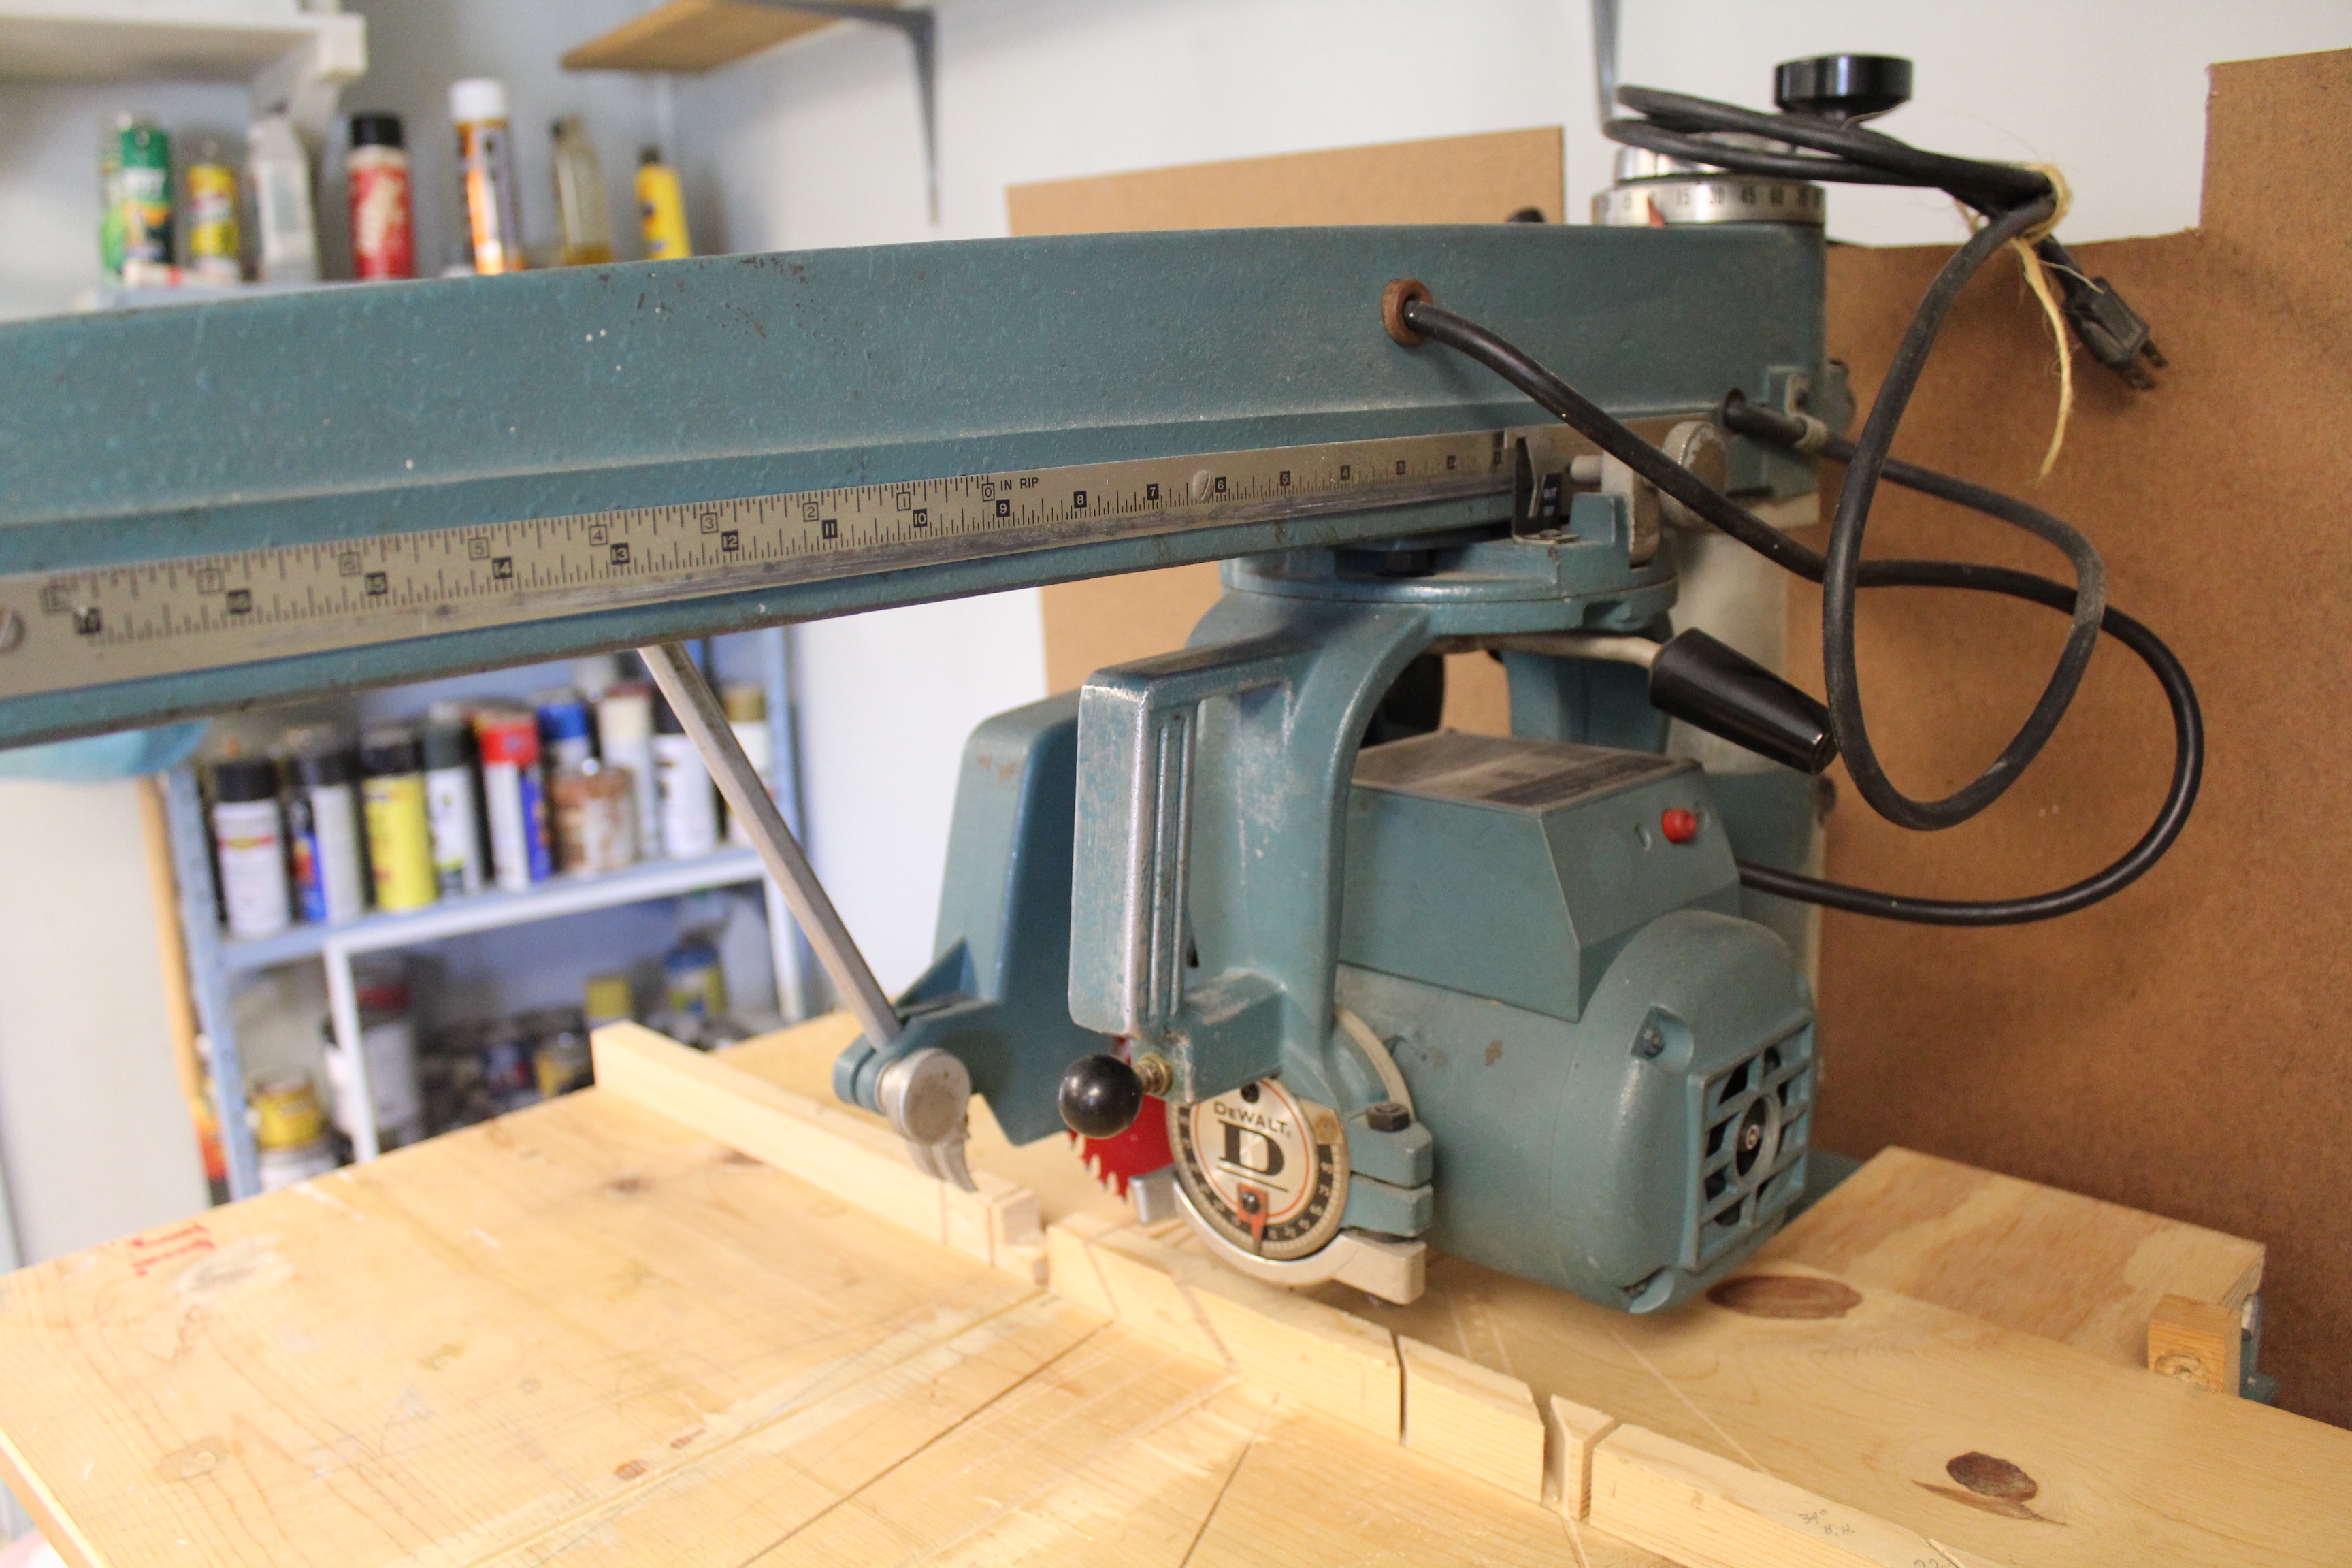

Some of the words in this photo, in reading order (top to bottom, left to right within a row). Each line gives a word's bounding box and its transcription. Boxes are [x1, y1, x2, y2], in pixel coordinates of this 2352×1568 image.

[1000, 480, 1013, 491] IN
[1020, 477, 1039, 489] RIP
[494, 561, 511, 576] 14
[613, 548, 628, 561] 13
[723, 534, 738, 548] 12
[914, 512, 927, 525] 10
[1218, 1118, 1284, 1177] D
